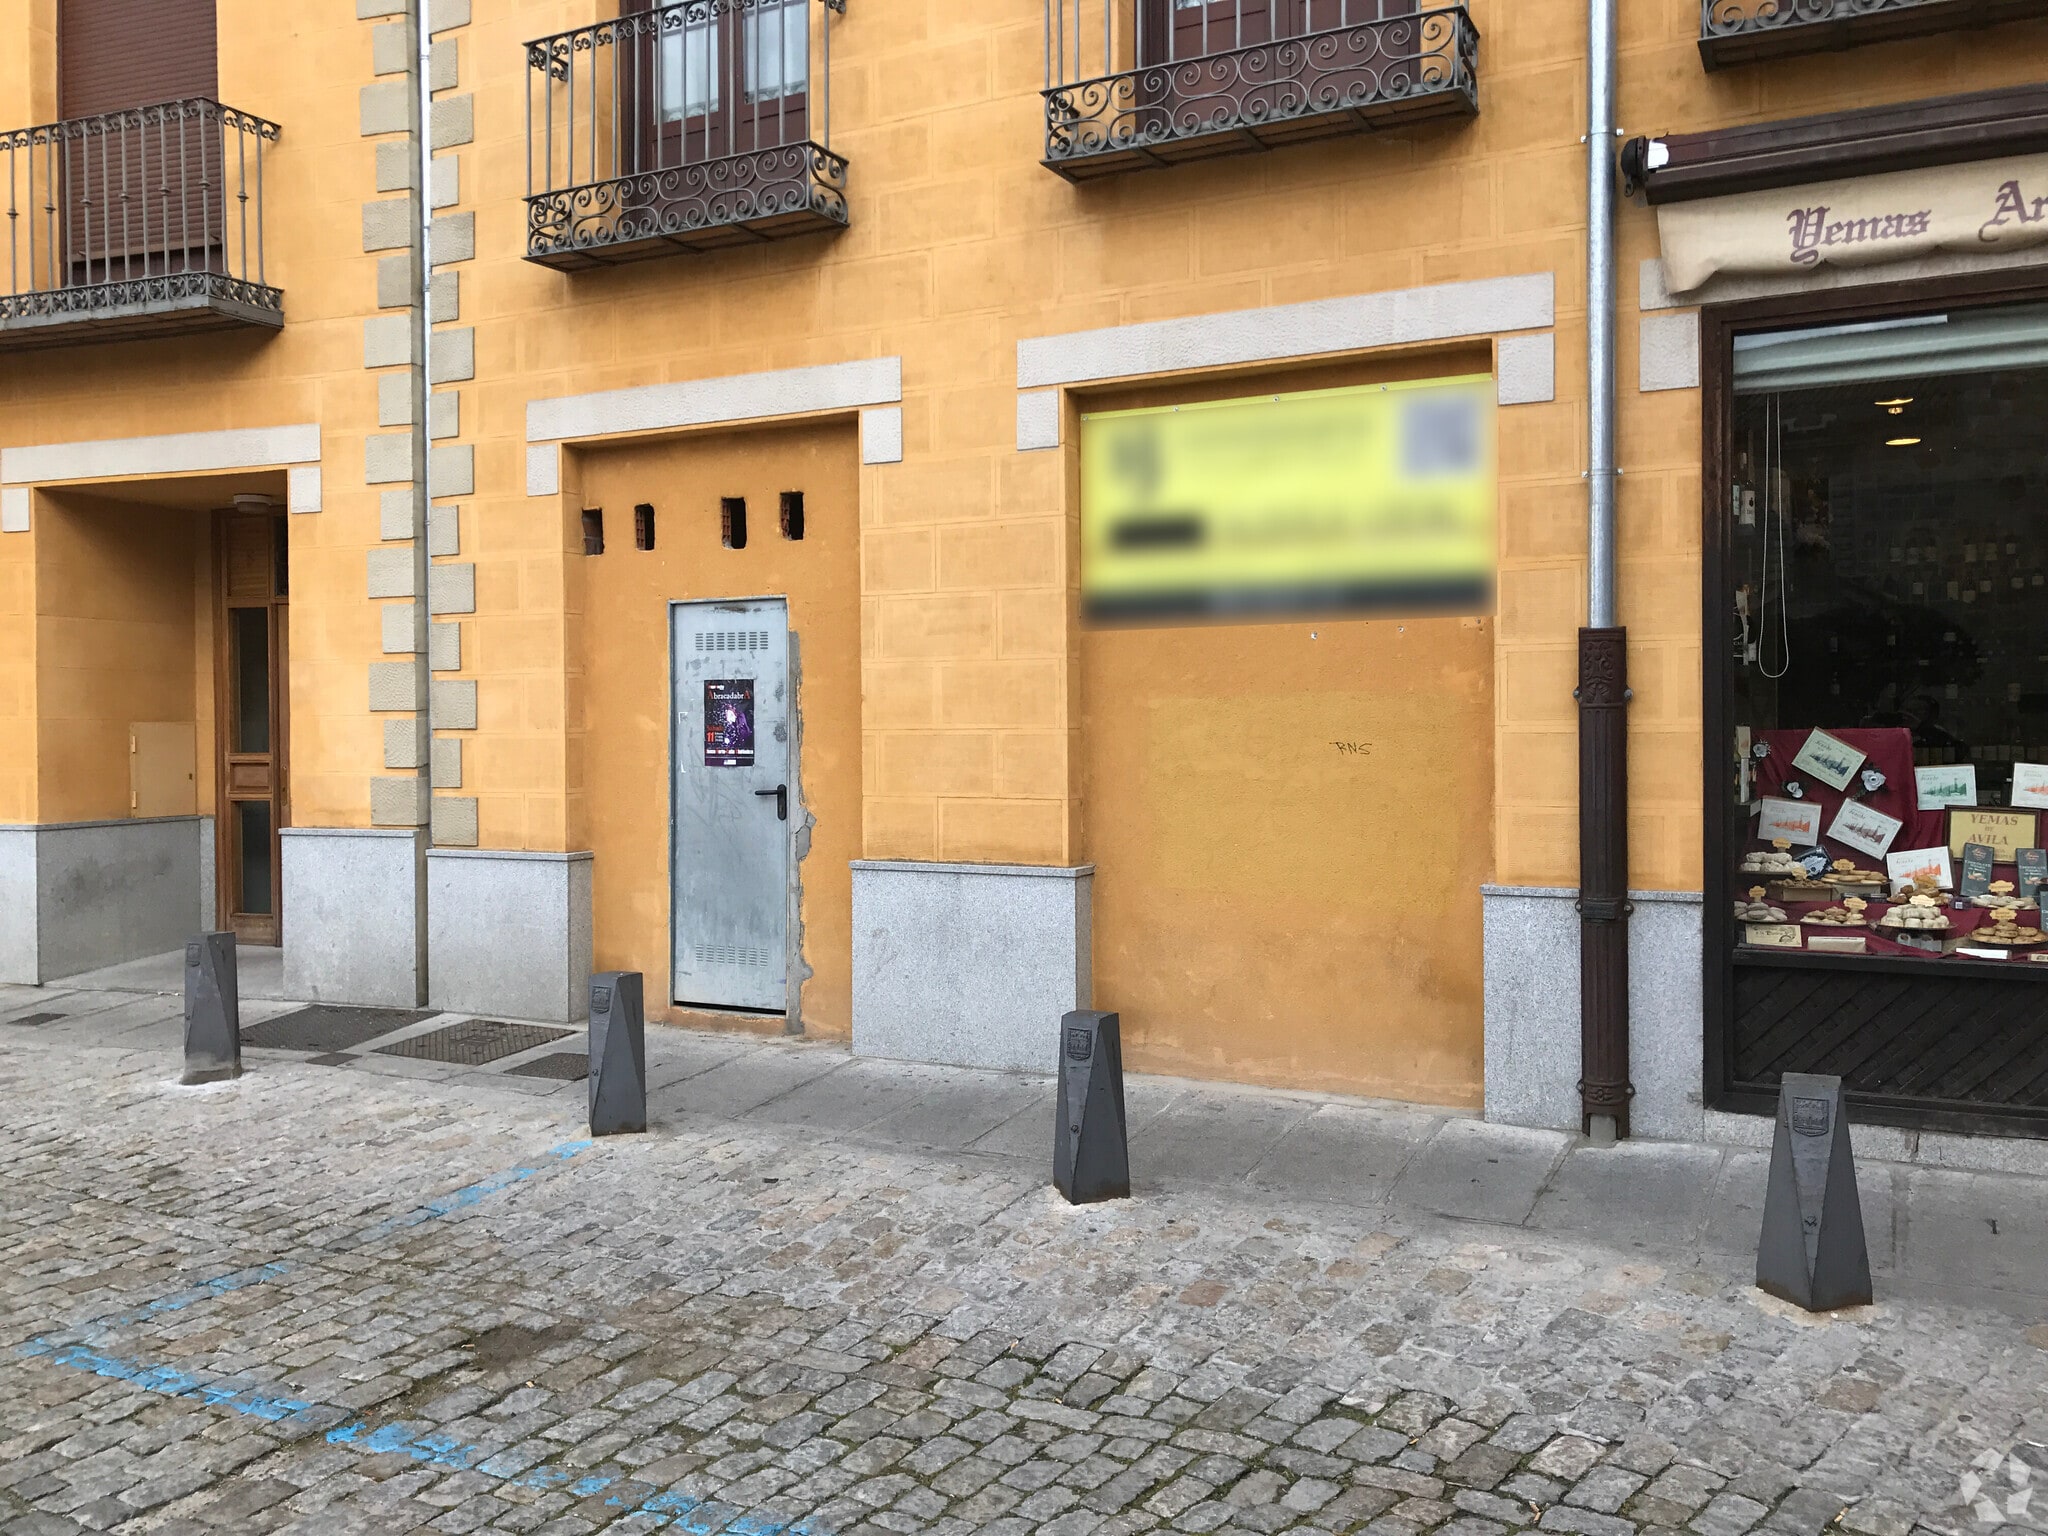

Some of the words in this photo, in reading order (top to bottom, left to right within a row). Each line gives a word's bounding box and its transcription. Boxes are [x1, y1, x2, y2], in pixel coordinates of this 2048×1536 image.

[1786, 205, 1932, 265] Yemas
[1971, 813, 2019, 826] YEMAS
[1967, 833, 2009, 846] AVILA
